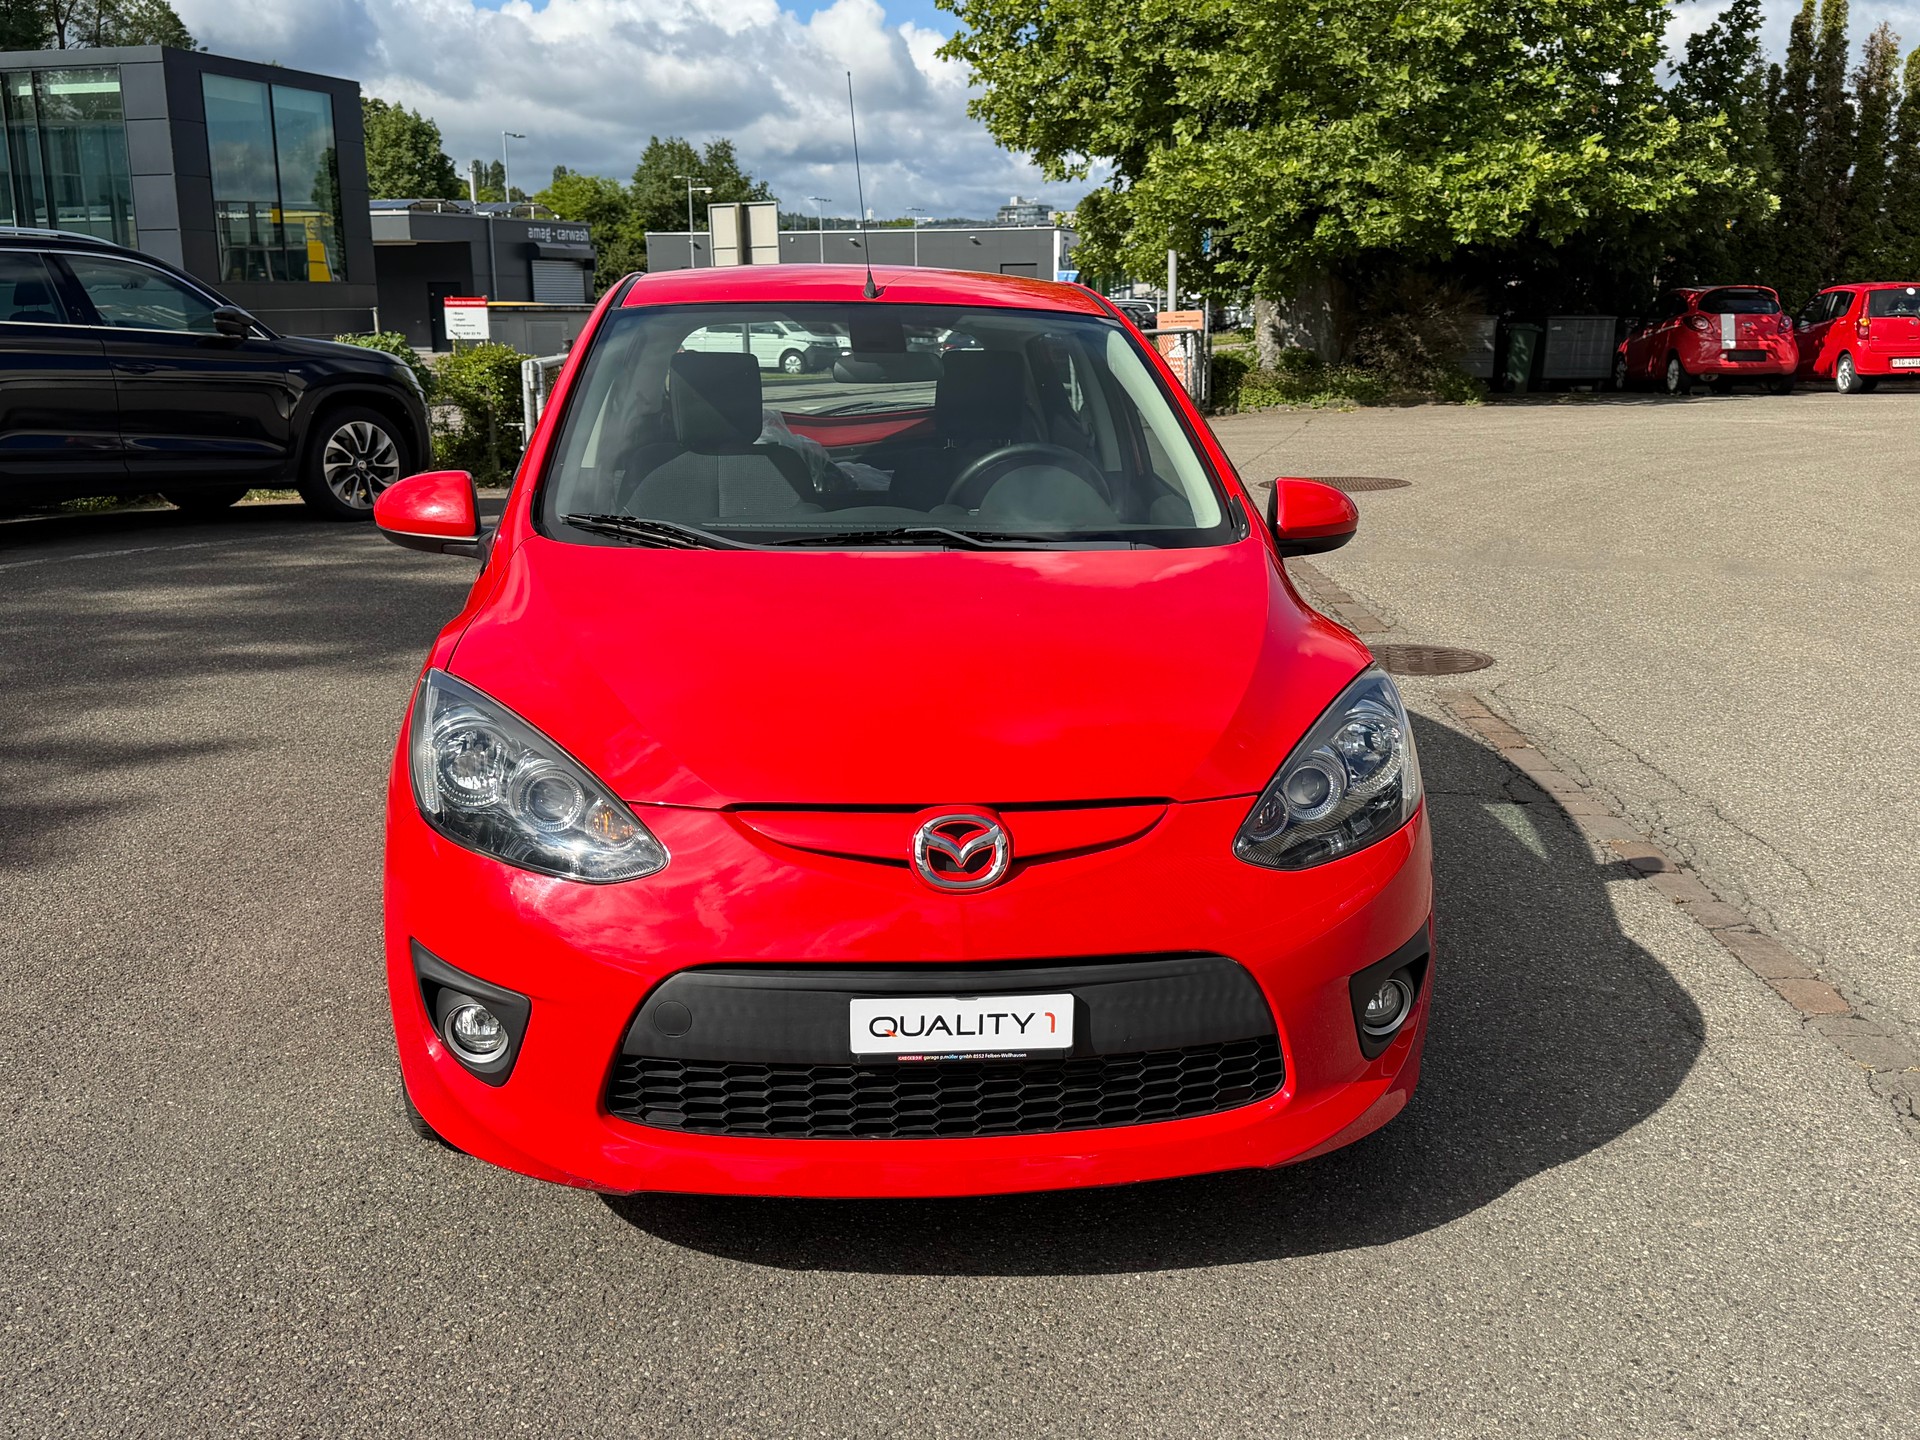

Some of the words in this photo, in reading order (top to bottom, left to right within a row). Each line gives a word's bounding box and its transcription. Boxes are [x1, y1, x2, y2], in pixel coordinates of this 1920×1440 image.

[528, 227, 551, 242] amag
[557, 228, 589, 241] carwash
[868, 1012, 1036, 1038] QUALITY
[1044, 1012, 1056, 1034] 1
